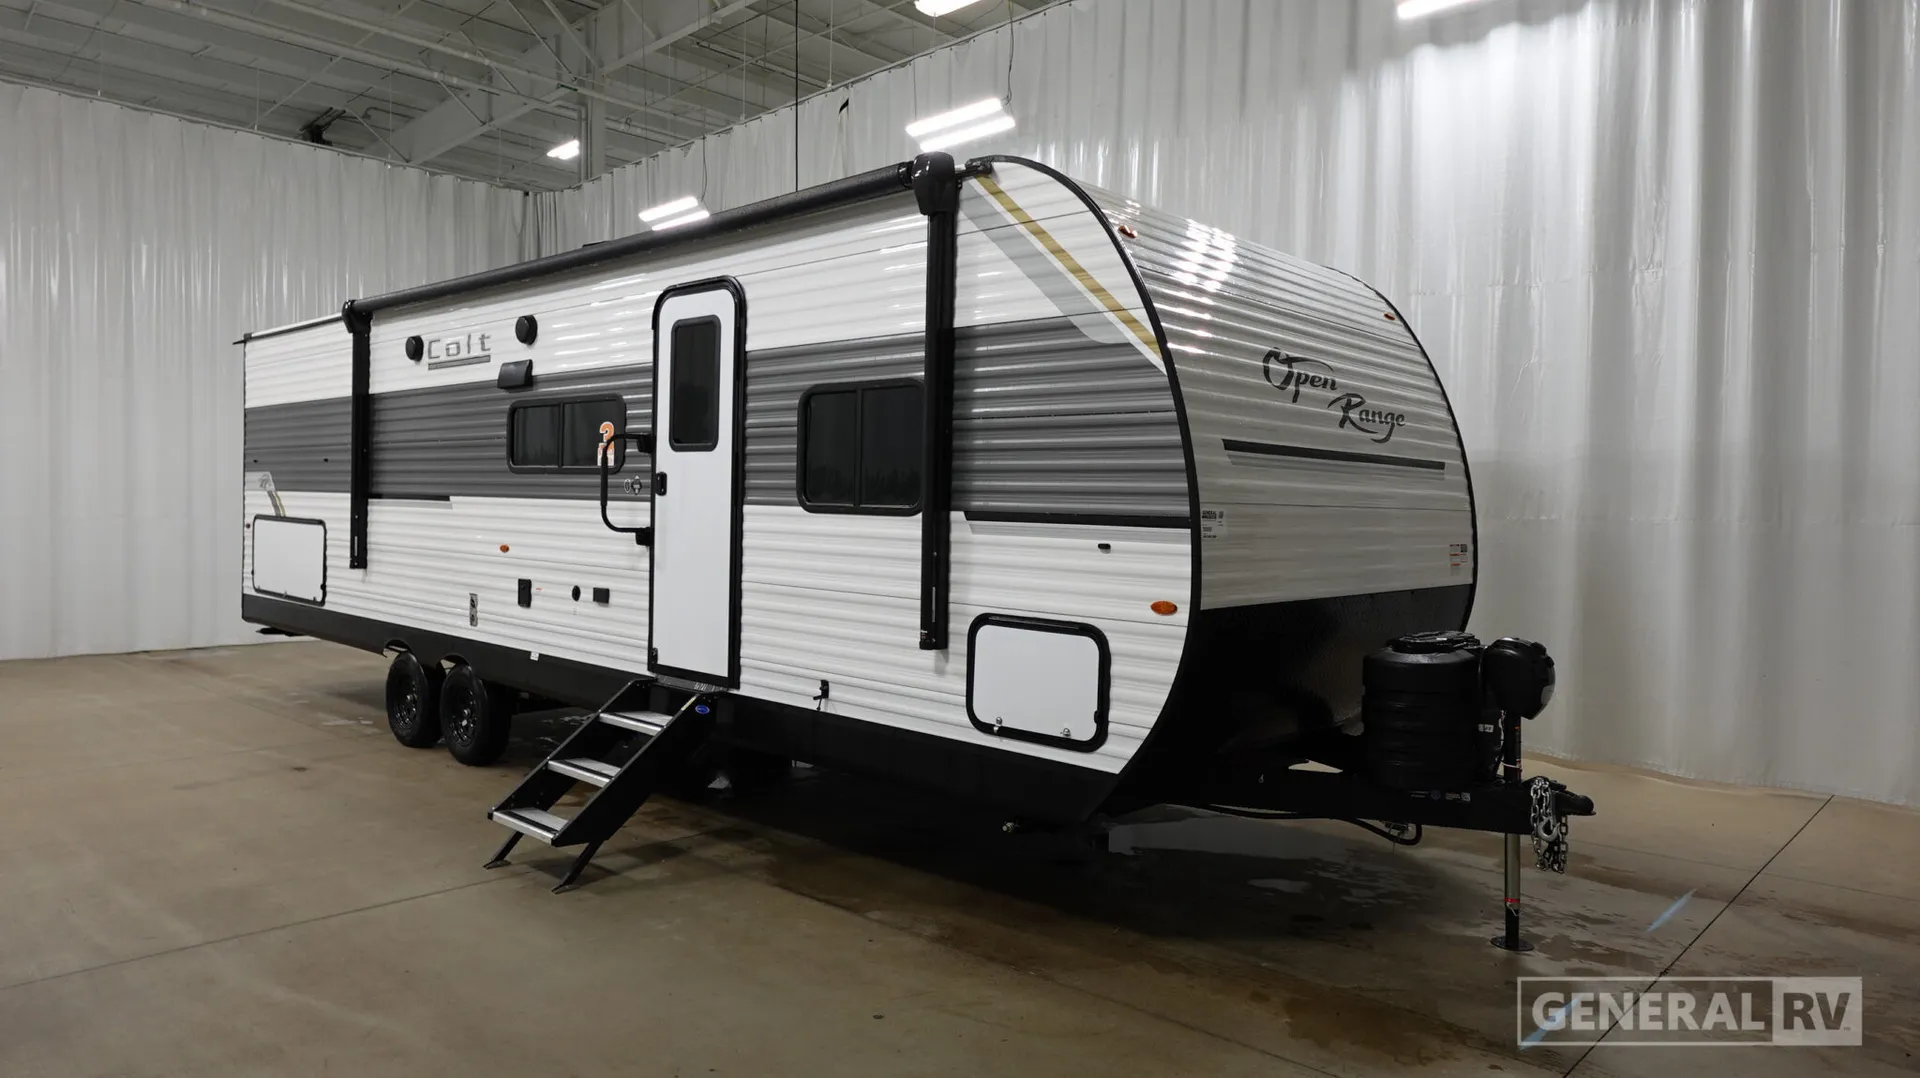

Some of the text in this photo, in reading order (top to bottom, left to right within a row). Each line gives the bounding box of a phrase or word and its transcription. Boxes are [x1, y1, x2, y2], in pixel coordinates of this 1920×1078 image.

[428, 333, 491, 359] Colt
[1262, 347, 1338, 403] Open
[1327, 393, 1406, 444] Range
